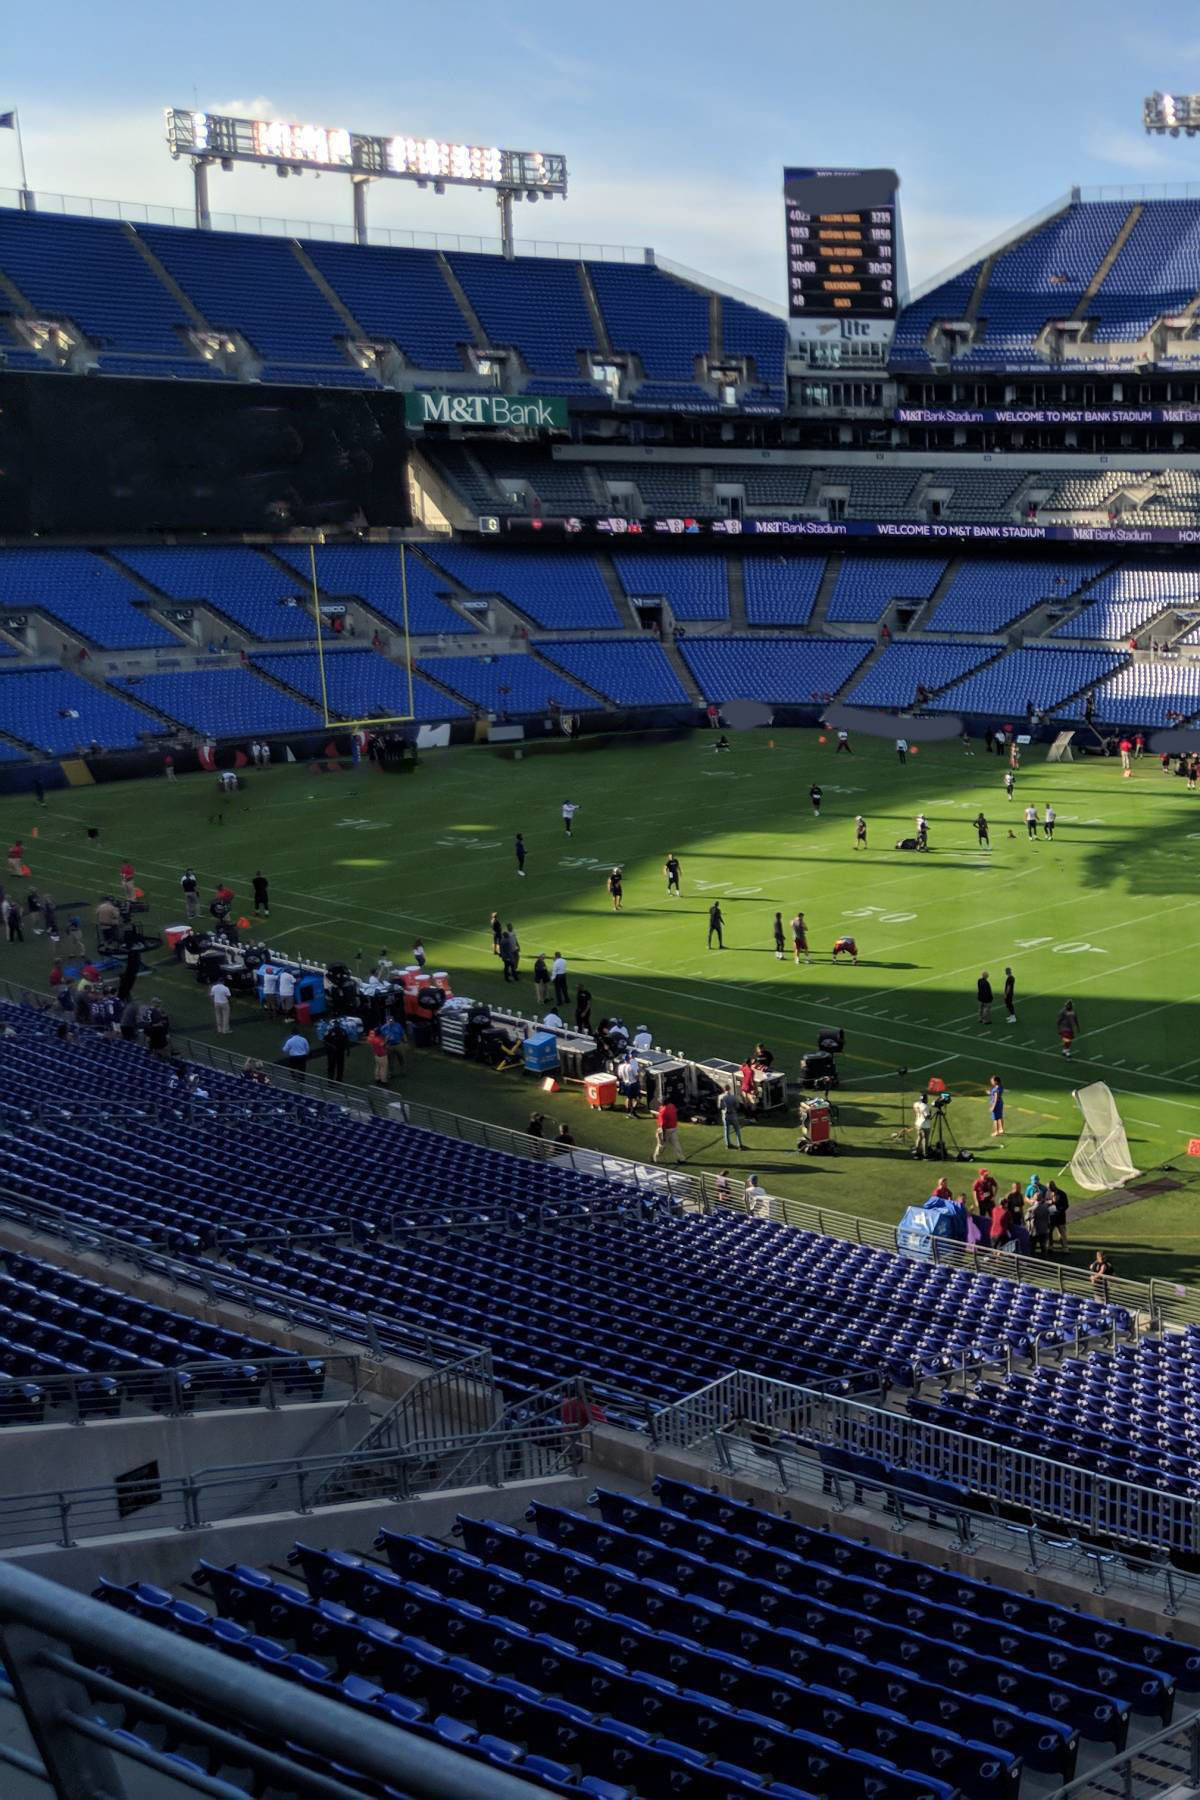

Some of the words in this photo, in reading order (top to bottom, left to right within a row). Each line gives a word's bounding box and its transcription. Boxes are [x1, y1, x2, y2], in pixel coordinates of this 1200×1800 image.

[841, 320, 870, 340] Lite
[422, 394, 489, 424] M&T
[492, 397, 555, 426] Bank
[900, 410, 924, 421] M&T
[924, 410, 945, 421] Bank
[946, 411, 983, 422] Stadium
[996, 411, 1044, 421] WELCOME
[1046, 411, 1060, 421] TO
[1062, 411, 1083, 421] M&T
[1085, 411, 1111, 421] BANK
[1112, 411, 1151, 422] STADIUM
[1162, 410, 1184, 421] M&T
[756, 521, 781, 533] M&T
[782, 522, 806, 534] Bank
[806, 522, 846, 535] Stadium
[877, 524, 930, 536] WELCOME
[932, 525, 948, 536] TO
[950, 526, 972, 536] M&T
[974, 526, 1000, 537] BANK
[1002, 527, 1046, 538] STADIUM
[1073, 528, 1095, 540] M&T
[1095, 529, 1117, 541] Bank
[1117, 528, 1152, 541] Stadium
[588, 1085, 598, 1100] G
